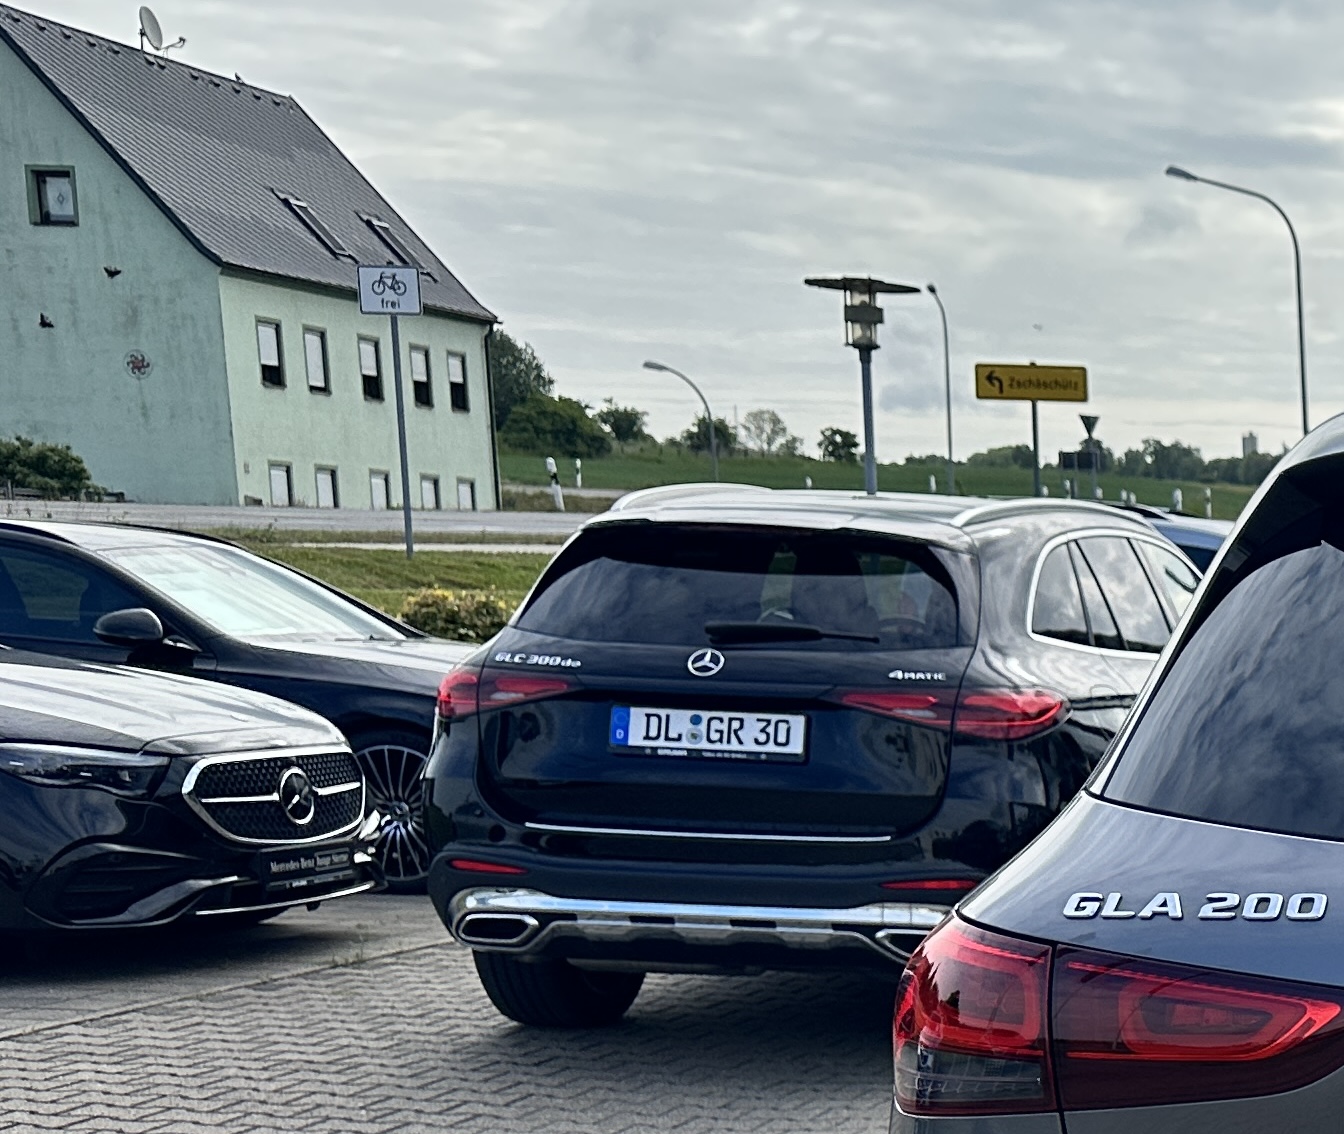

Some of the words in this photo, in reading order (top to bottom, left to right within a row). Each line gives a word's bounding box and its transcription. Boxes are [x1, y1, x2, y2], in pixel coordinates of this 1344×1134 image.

[381, 298, 400, 309] frei
[495, 652, 526, 664] GLC
[643, 713, 683, 742] DL
[706, 716, 744, 745] GR
[754, 717, 792, 747] 30
[1063, 892, 1183, 919] GLA
[1197, 892, 1328, 920] 200
